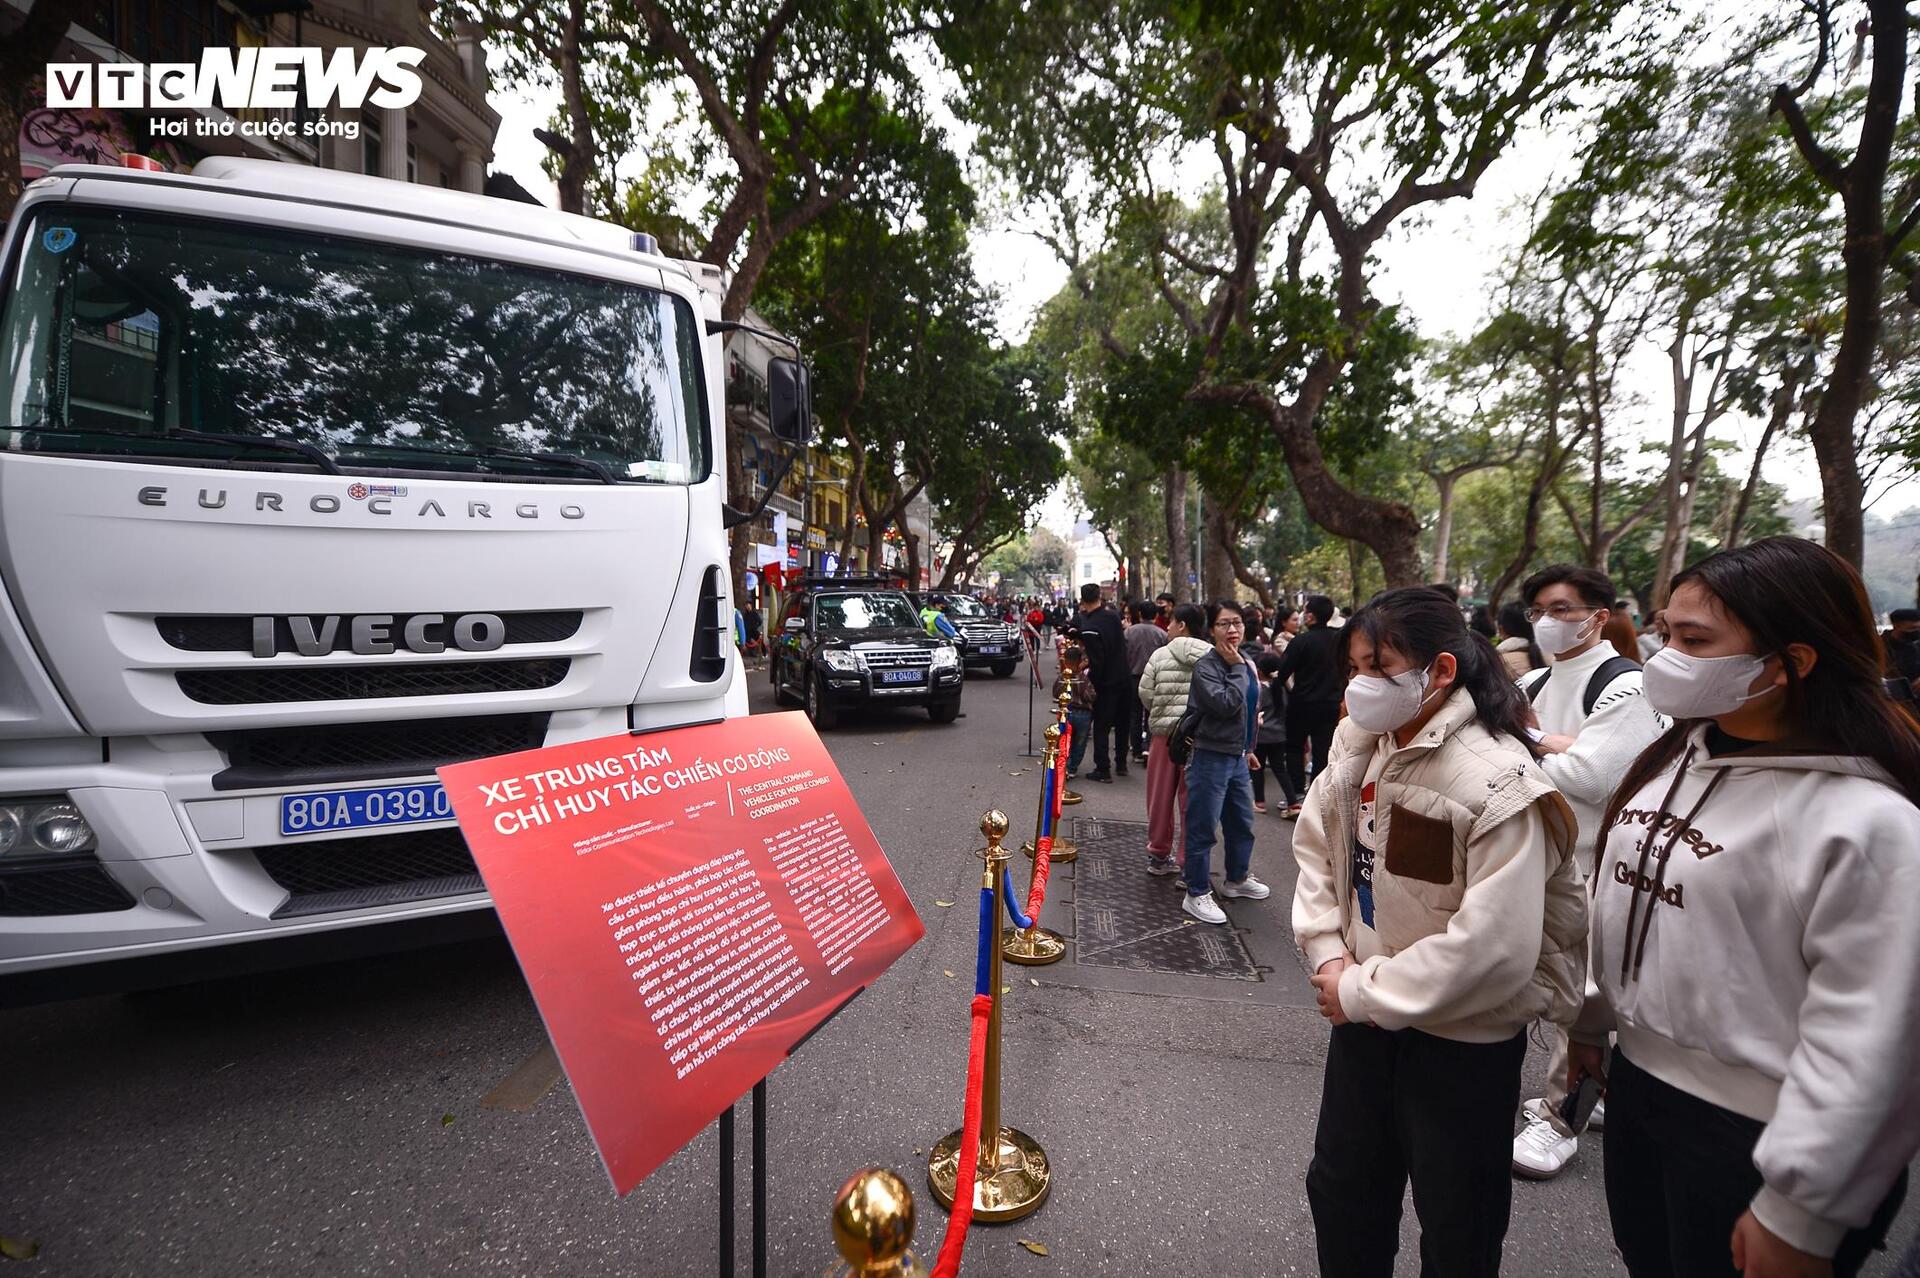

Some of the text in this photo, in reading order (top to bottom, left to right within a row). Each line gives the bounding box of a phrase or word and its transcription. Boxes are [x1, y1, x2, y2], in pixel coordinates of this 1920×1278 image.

[137, 485, 586, 520] EUROCARGO
[252, 613, 506, 659] IVECO
[478, 746, 672, 806] XE TRUNG TÂM
[494, 747, 790, 834] CHỈ HUY TÁC CHIẾN CƠ ĐỘNG
[737, 769, 813, 795] THE CENTRAL COMMAND
[743, 775, 830, 807] VEHICLE FOR MOBILE COMBAT
[288, 787, 452, 829] 80A-039.0
[749, 796, 800, 818] COORDINATION
